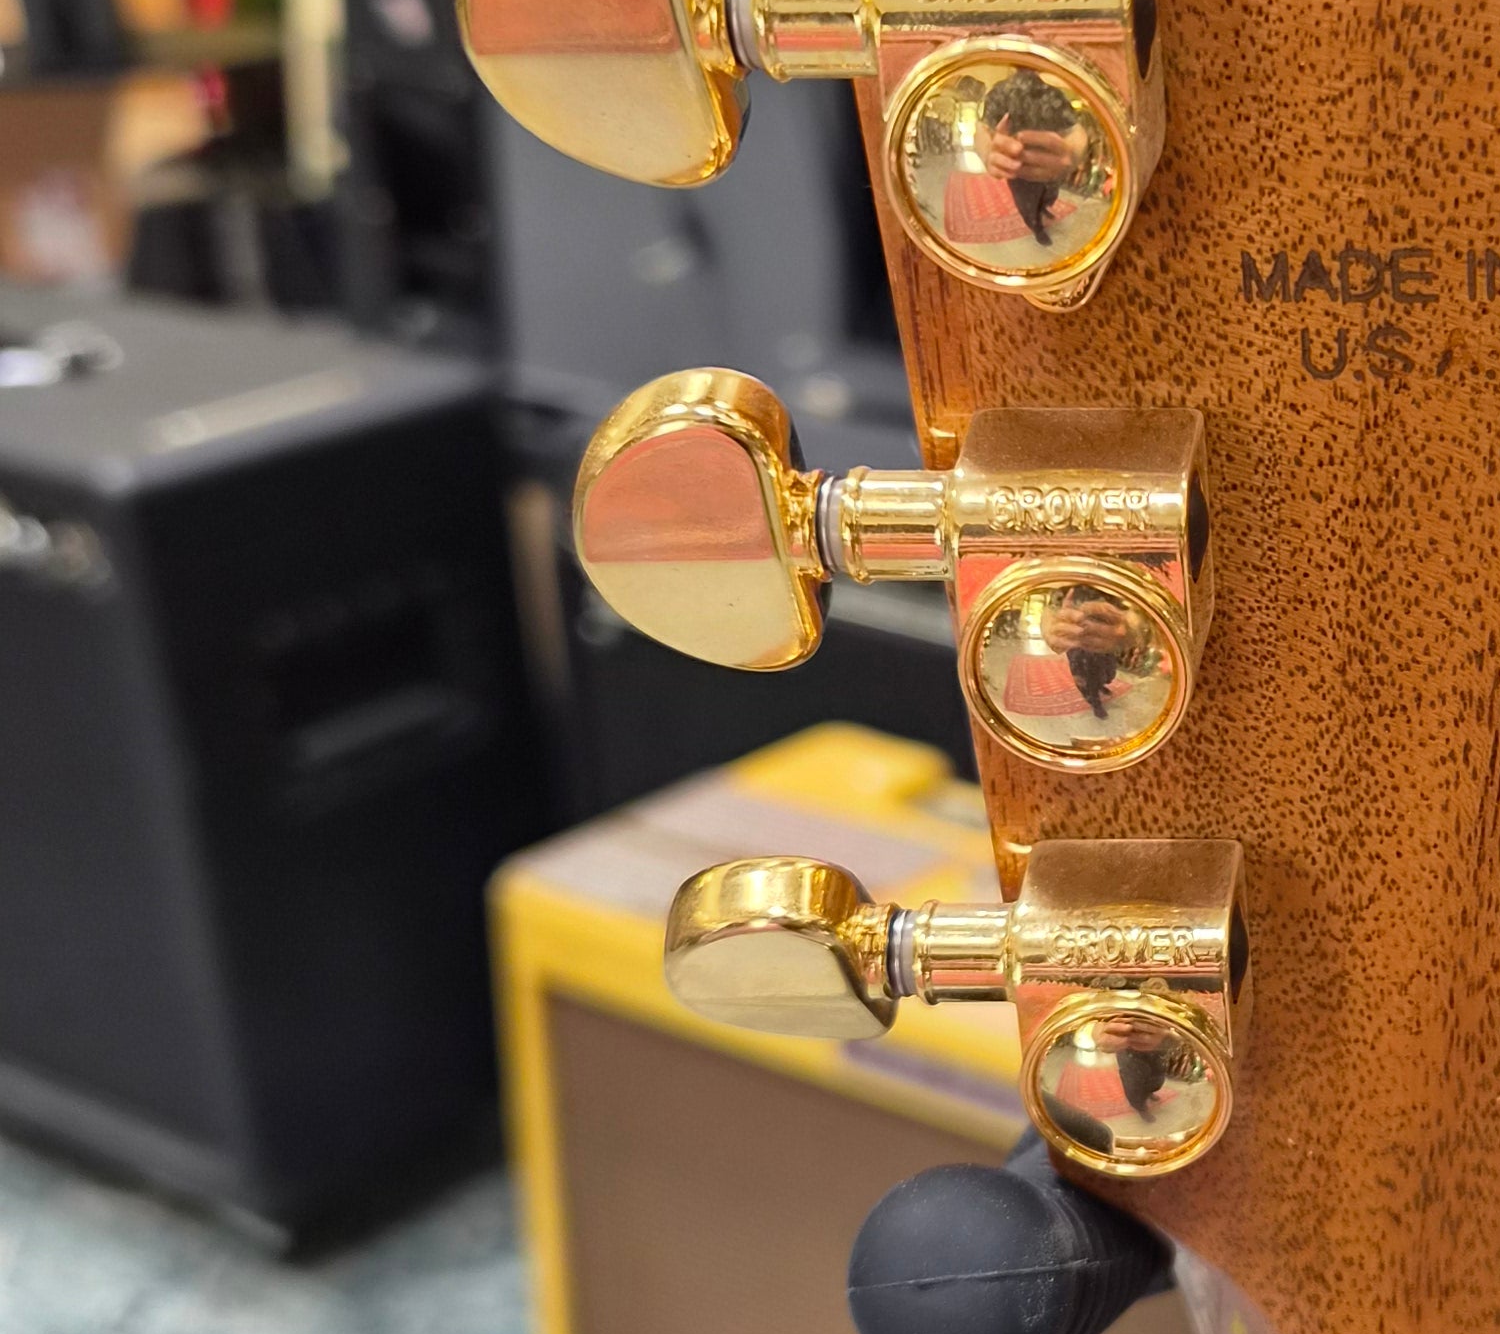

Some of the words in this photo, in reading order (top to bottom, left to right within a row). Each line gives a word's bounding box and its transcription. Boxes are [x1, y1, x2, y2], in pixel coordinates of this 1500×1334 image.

[1240, 248, 1440, 304] MADE
[987, 485, 1150, 532] GROVER
[1048, 924, 1198, 966] GROVER
